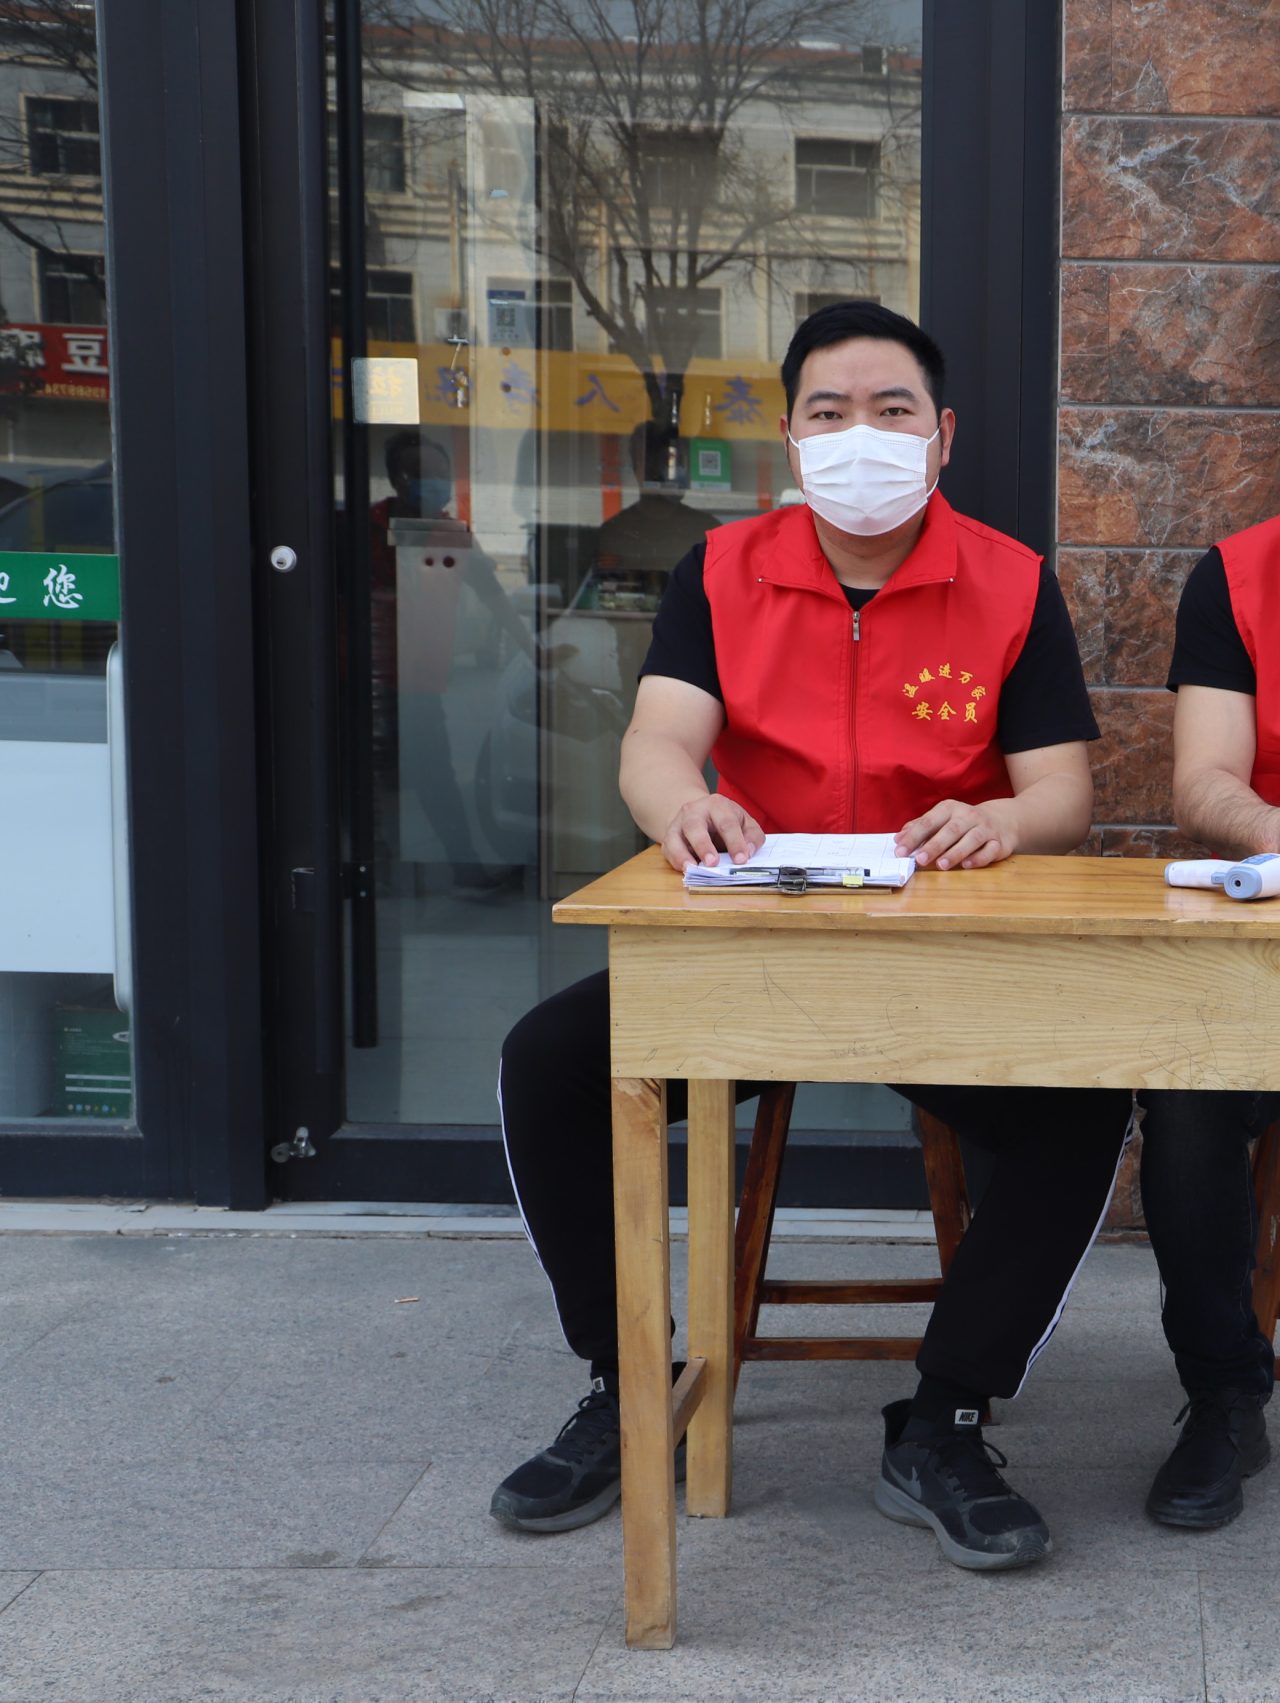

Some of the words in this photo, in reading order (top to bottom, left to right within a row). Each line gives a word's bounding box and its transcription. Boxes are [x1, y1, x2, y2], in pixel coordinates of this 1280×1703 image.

[901, 662, 986, 701] 温暖进万家
[911, 701, 978, 723] 安全员
[959, 1411, 975, 1423] NIKE
